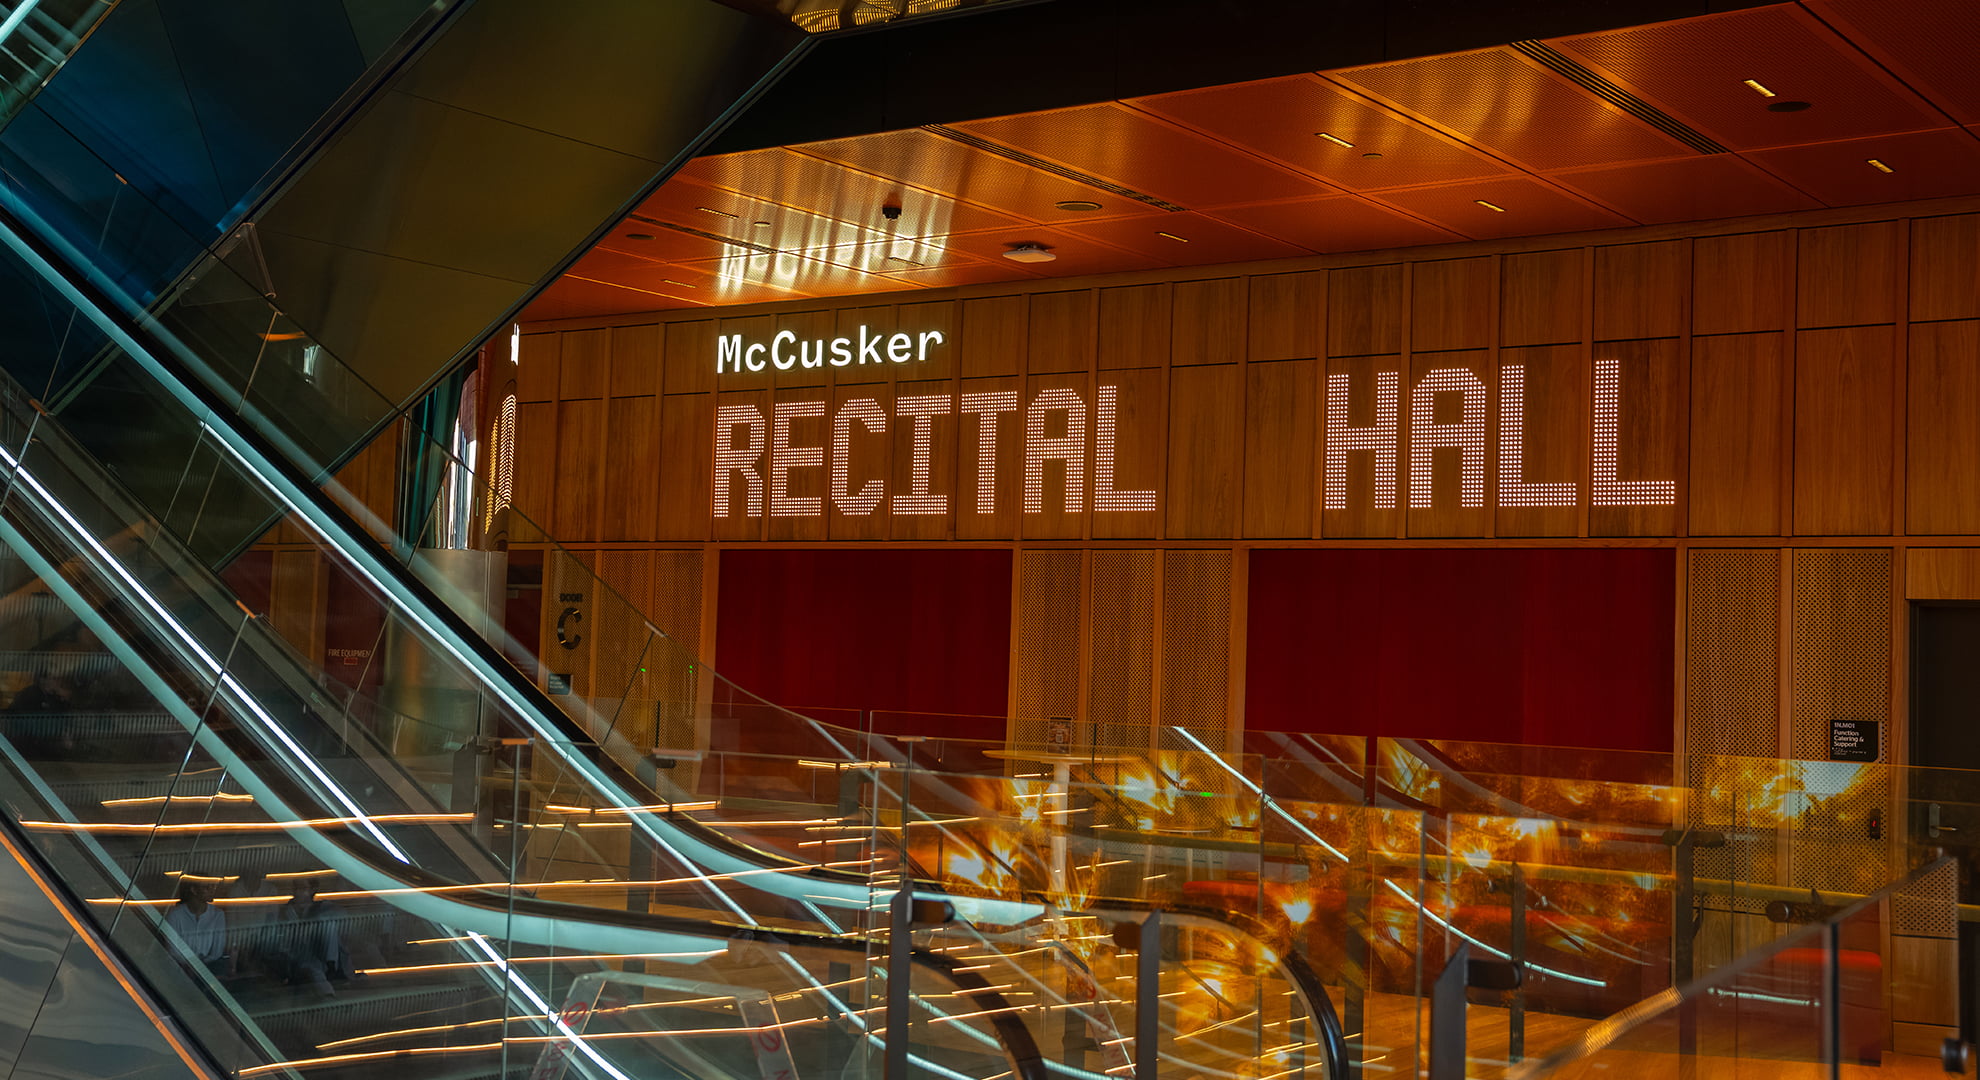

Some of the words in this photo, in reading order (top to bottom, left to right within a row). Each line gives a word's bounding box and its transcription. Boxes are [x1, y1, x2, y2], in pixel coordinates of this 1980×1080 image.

[717, 324, 944, 374] McCusker
[713, 384, 1157, 518] RECITAL
[1325, 359, 1675, 510] HALL
[559, 593, 583, 602] DOOR
[557, 607, 582, 650] C
[328, 648, 340, 657] FIRE
[341, 649, 372, 658] EQUIPMEN
[1833, 735, 1858, 743] Catering
